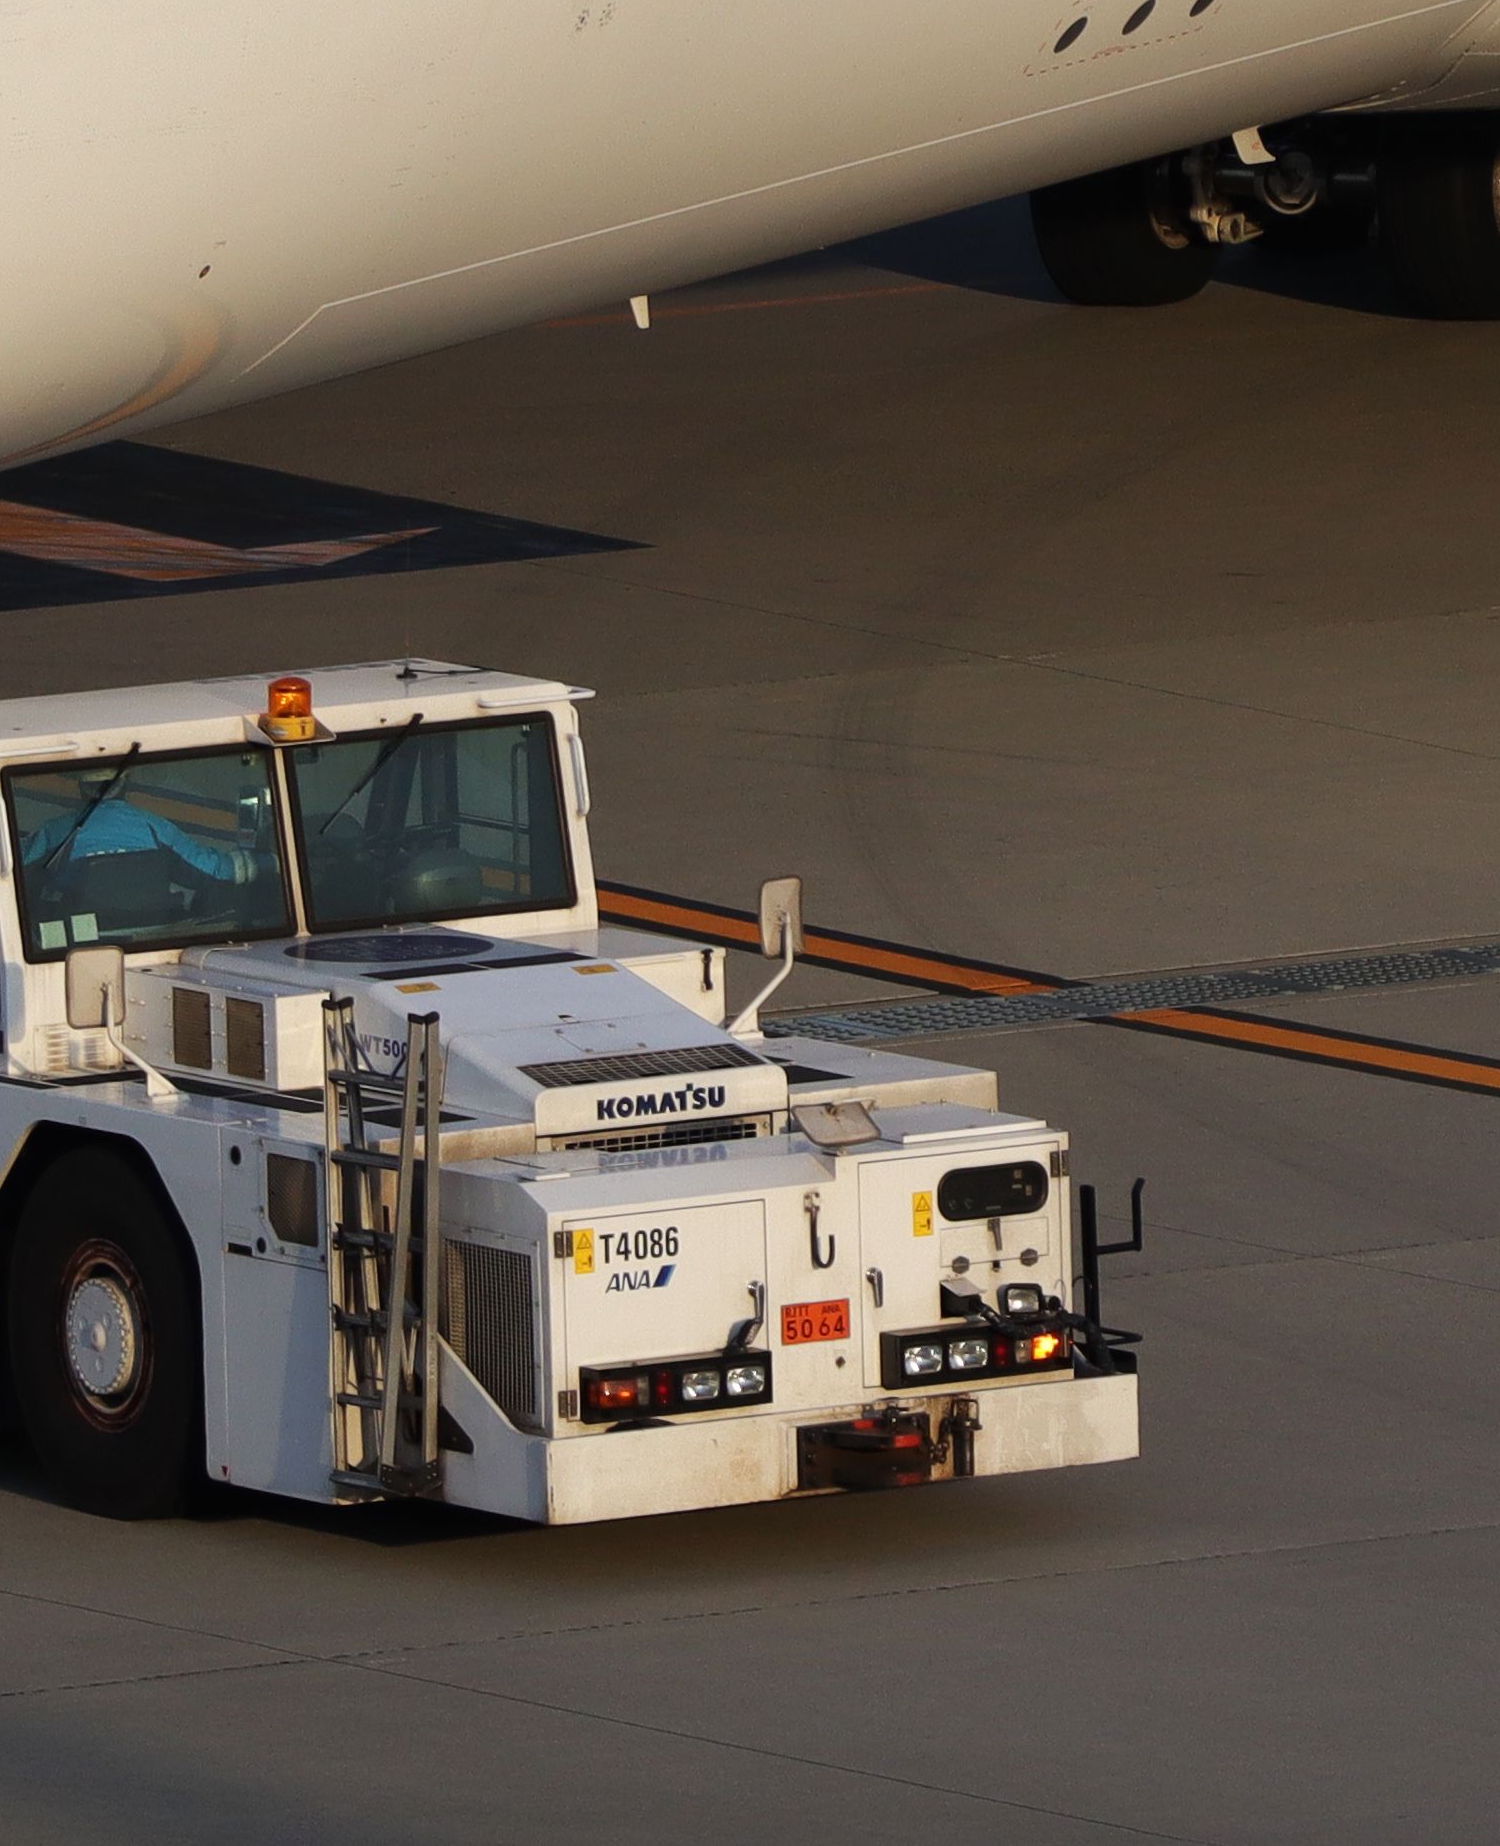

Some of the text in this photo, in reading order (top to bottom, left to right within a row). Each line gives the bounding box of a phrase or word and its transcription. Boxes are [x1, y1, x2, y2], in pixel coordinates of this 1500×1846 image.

[596, 1083, 726, 1121] KOMATSU
[599, 1226, 680, 1265] T4086
[605, 1269, 651, 1294] ANA
